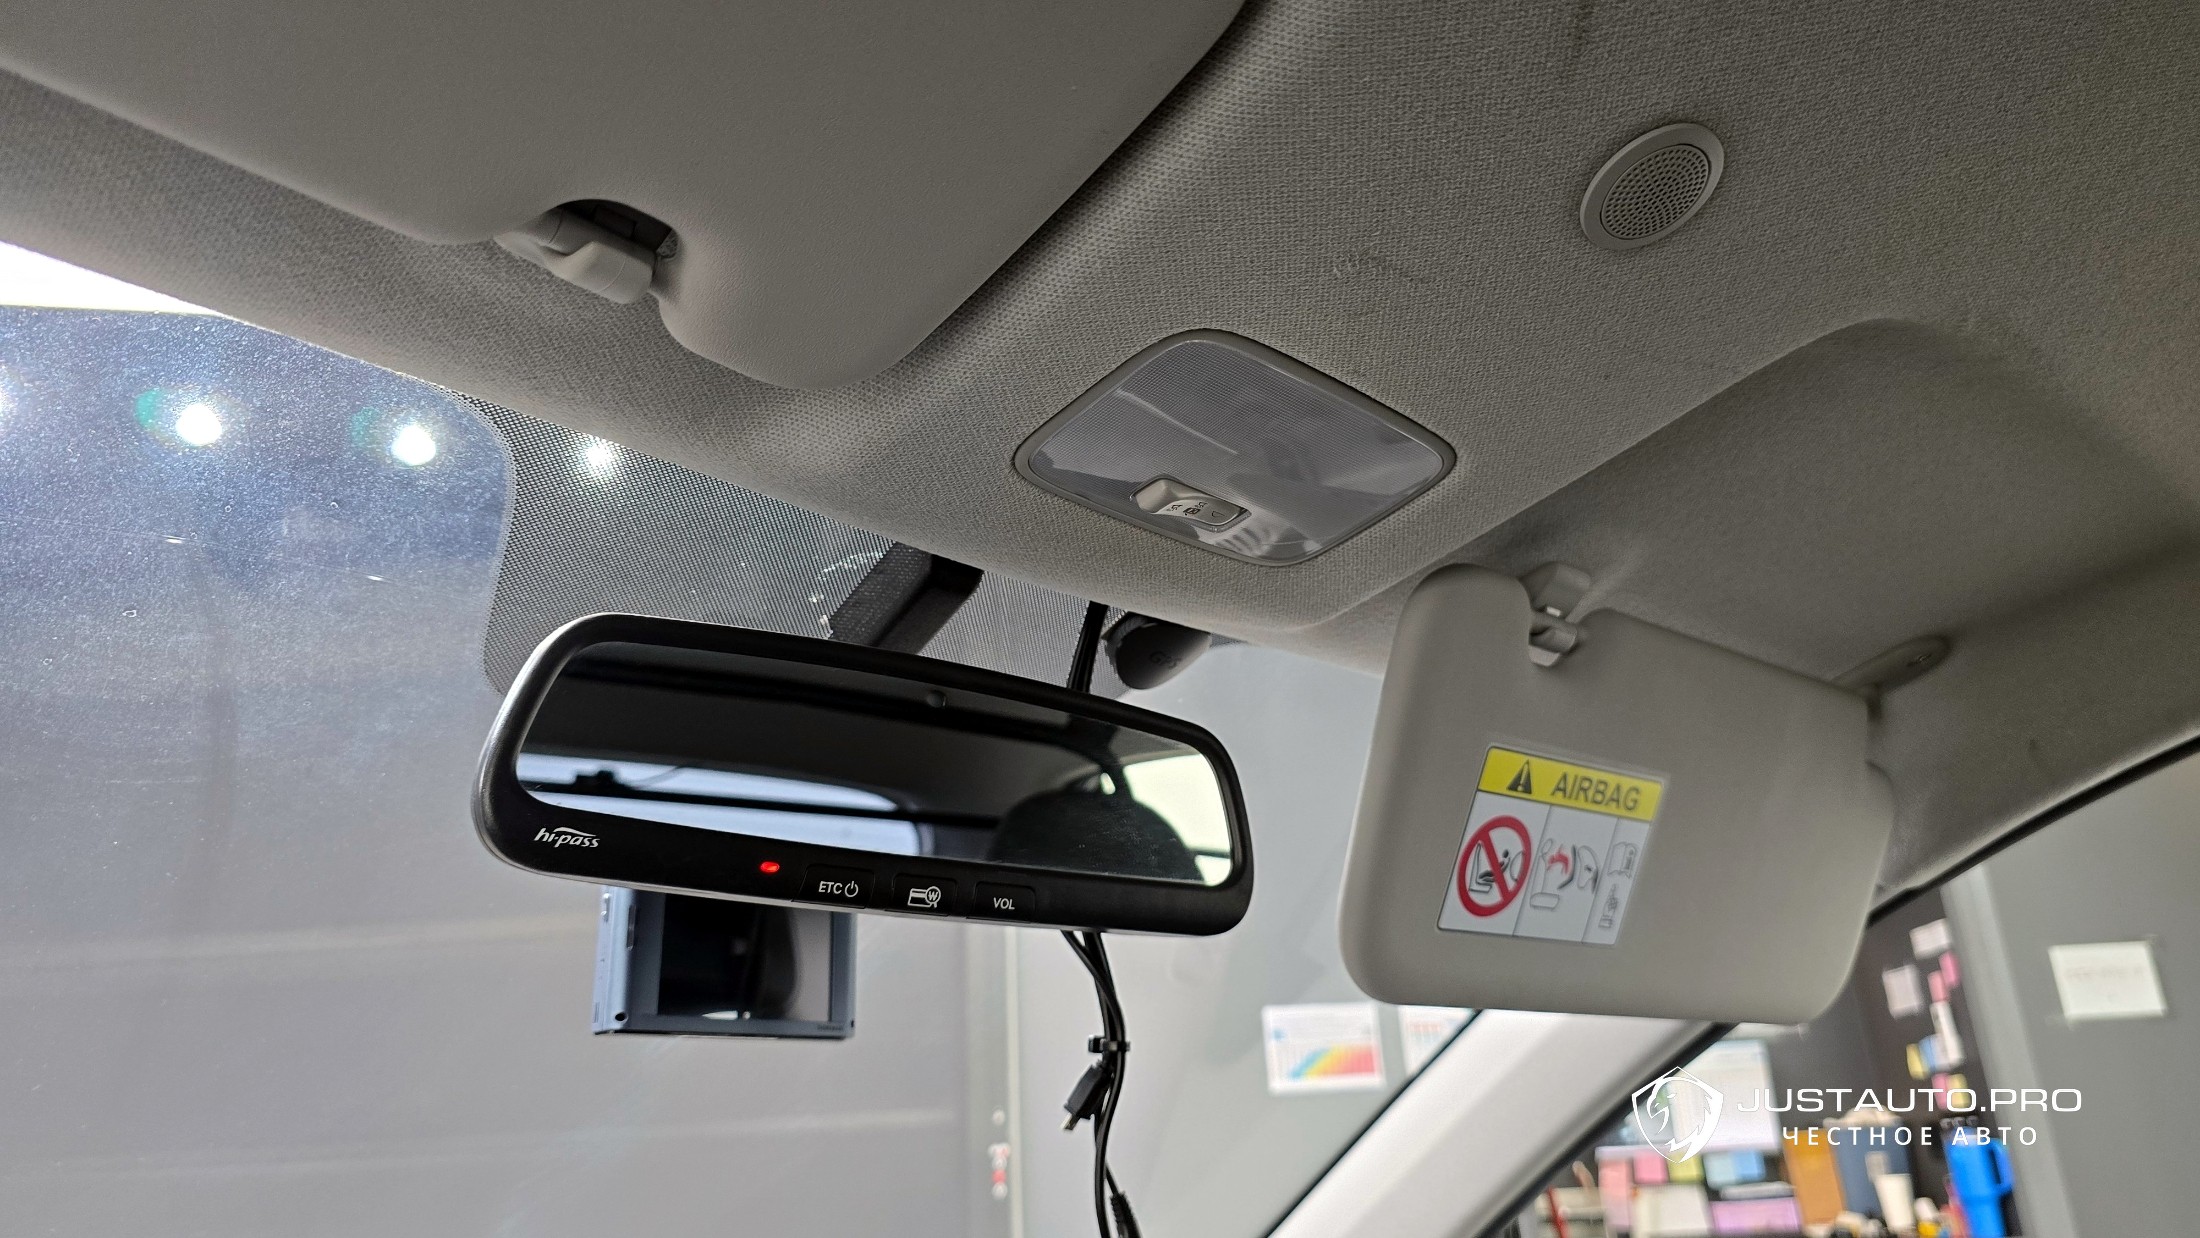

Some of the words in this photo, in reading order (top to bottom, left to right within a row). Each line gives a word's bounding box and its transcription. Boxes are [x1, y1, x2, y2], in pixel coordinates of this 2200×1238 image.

[1149, 650, 1182, 670] GPS
[1551, 771, 1641, 812] AIRBAG
[534, 827, 600, 848] hi-pass
[818, 881, 843, 895] ETC
[993, 897, 1016, 911] VOL
